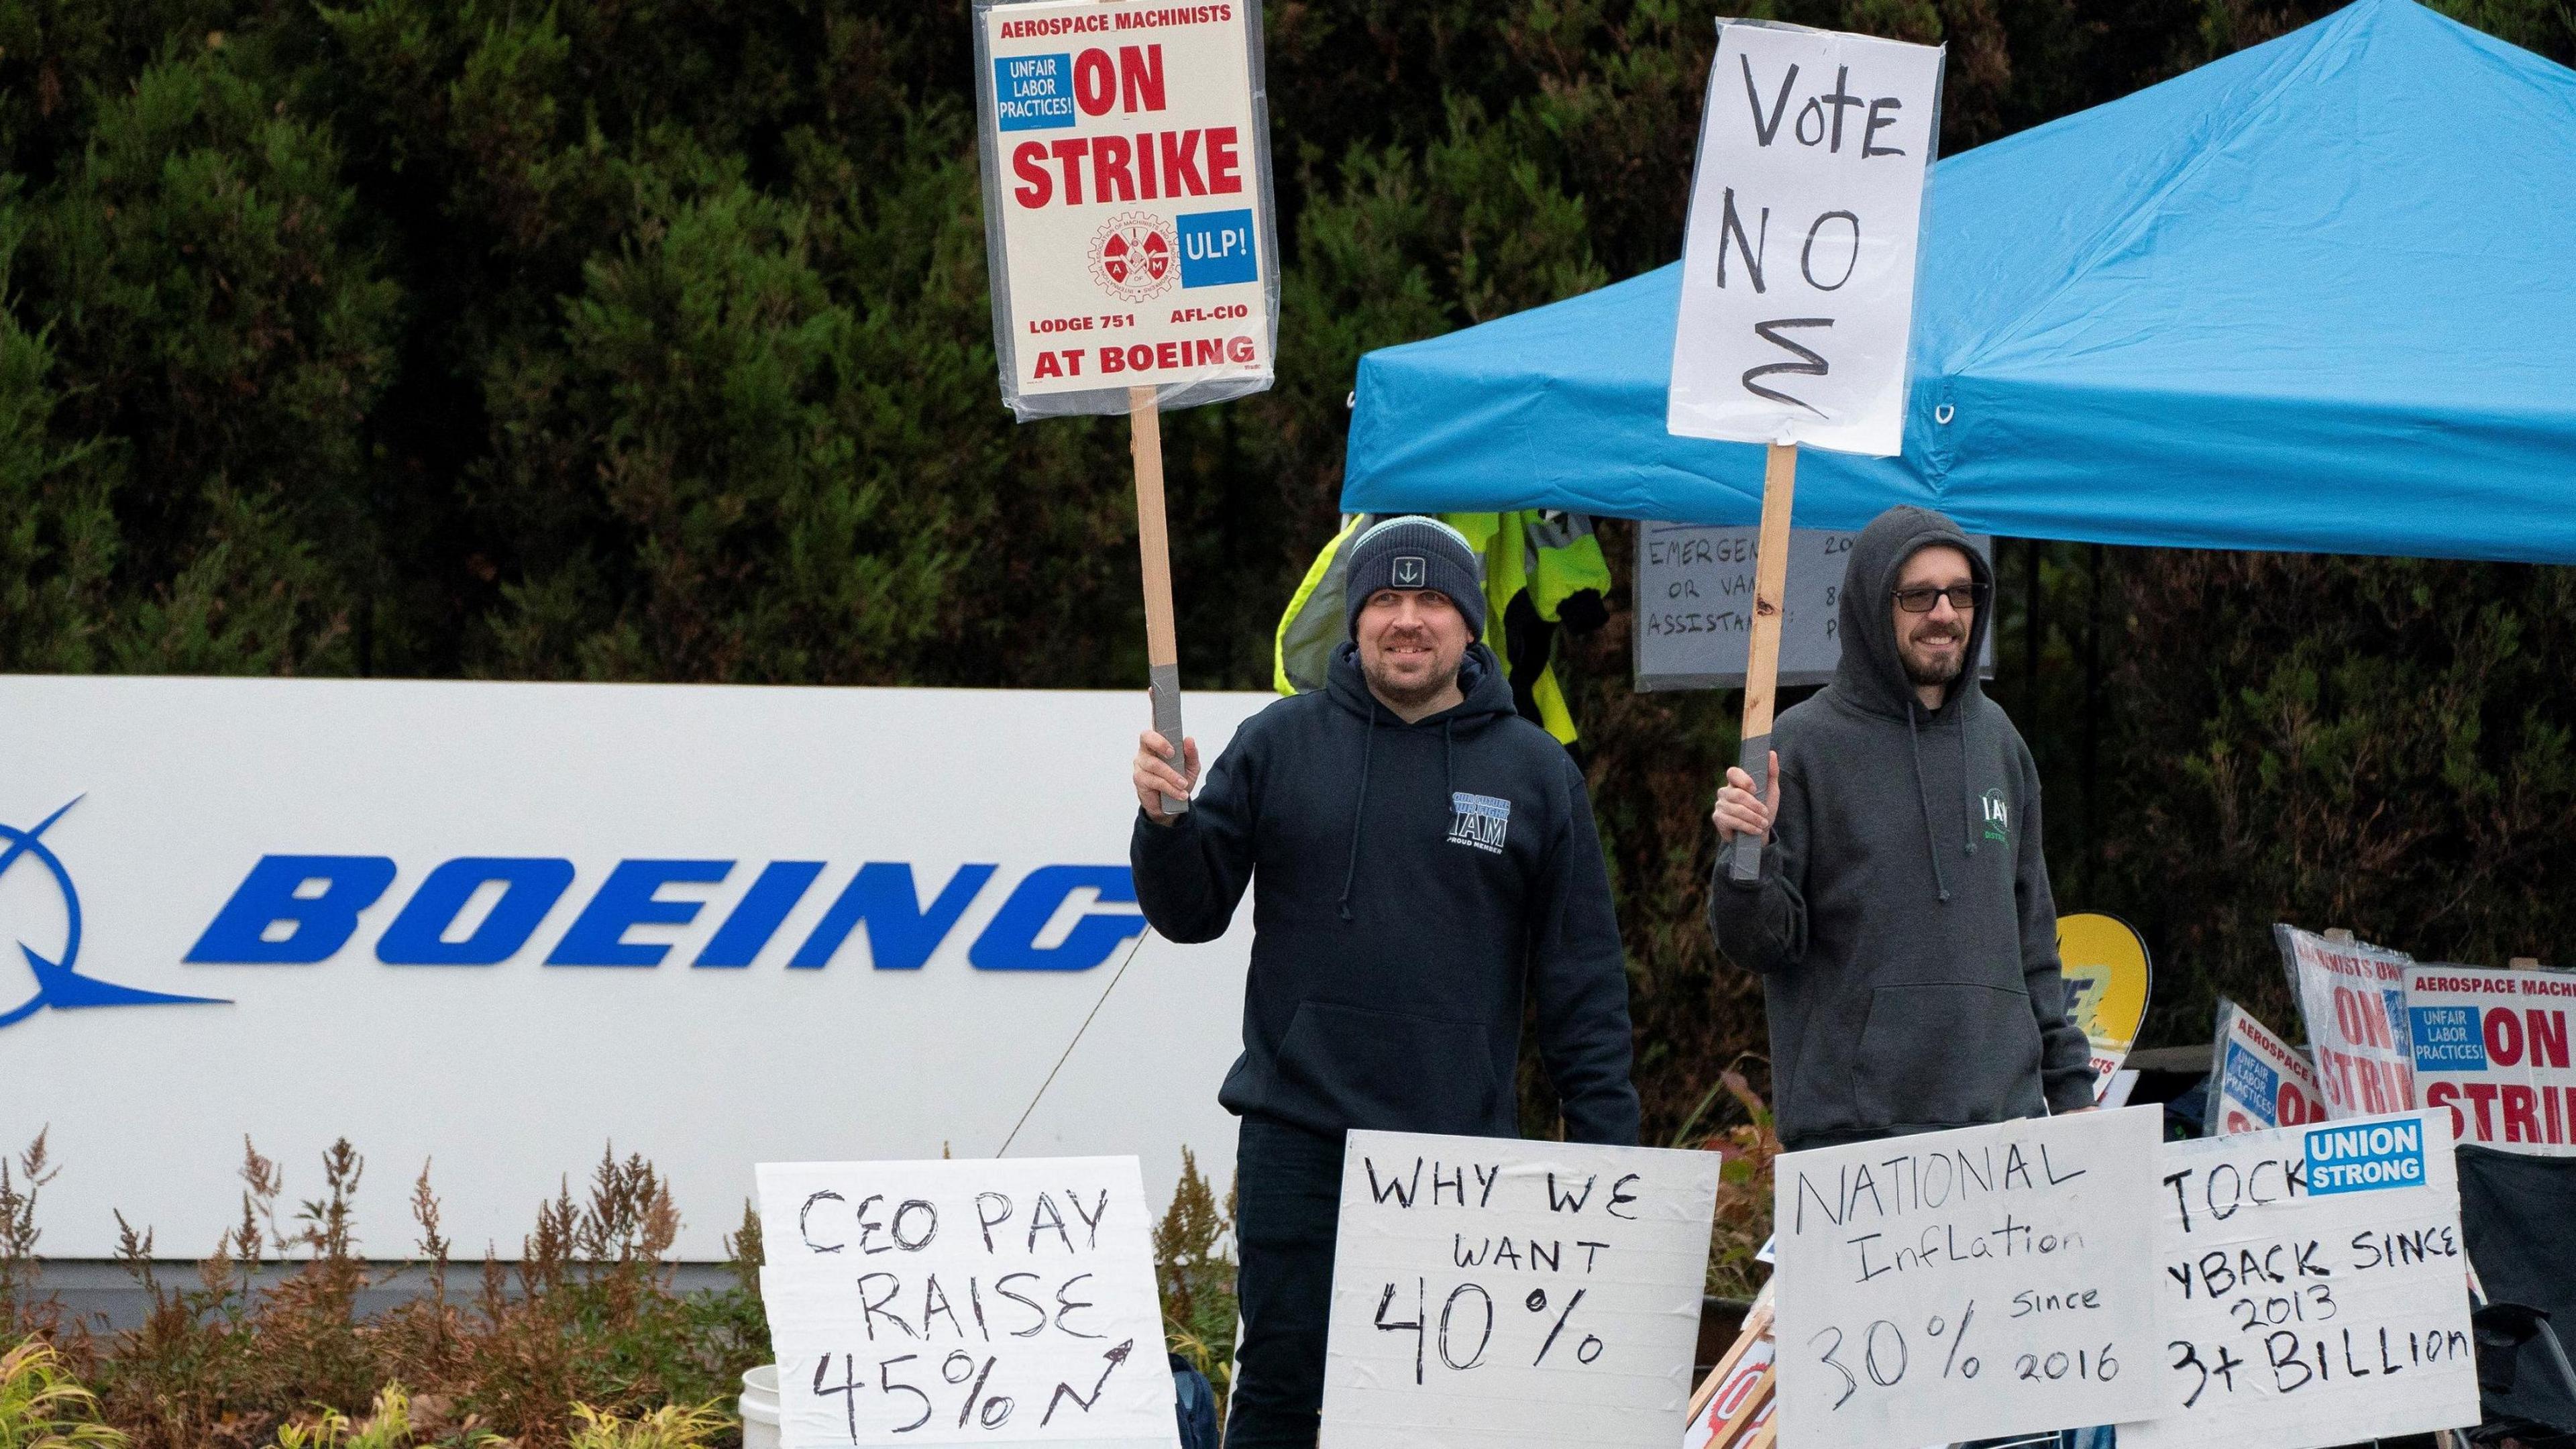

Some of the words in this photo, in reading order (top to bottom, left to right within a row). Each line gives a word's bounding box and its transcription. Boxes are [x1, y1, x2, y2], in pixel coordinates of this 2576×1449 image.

[1001, 15, 1109, 39] AEROSPACE
[1115, 4, 1232, 30] MACHINISTS
[1010, 59, 1057, 78] UNFAIR
[1073, 44, 1167, 117] ON
[1014, 78, 1056, 97] LABOR
[1000, 97, 1072, 118] PRACTICES!
[1012, 126, 1242, 209] STRIKE
[1124, 219, 1159, 230] MACHINISTS
[1186, 228, 1246, 260] ULP!
[1112, 263, 1122, 274] A
[1152, 261, 1163, 270] M
[1030, 317, 1093, 333] LODGE
[1100, 314, 1134, 329] 751
[1170, 304, 1248, 323] AFL-CIO
[1033, 349, 1085, 379] AT
[1099, 335, 1255, 374] BOEING
[1669, 579, 1699, 598] OR
[1449, 812, 1507, 847] IAM
[1474, 842, 1502, 855] MEMBER
[180, 855, 1148, 972] BOEING
[2415, 976, 2516, 994] AEROSPACE
[2333, 985, 2392, 1050] ON
[2423, 1010, 2467, 1025] UNFAIR
[2428, 1027, 2467, 1042] LABOR
[2238, 1018, 2308, 1081] AEROSPACE
[2416, 1044, 2483, 1060] PRACTICES!
[2483, 1006, 2571, 1069] ON
[2238, 1065, 2267, 1095] LABOR
[2310, 1125, 2418, 1161] UNION
[1364, 1157, 1499, 1208] WHY
[1548, 1172, 1640, 1220] WE
[1796, 1144, 2086, 1235] NATIONAL
[2312, 1157, 2420, 1188] STRONG
[800, 1189, 939, 1254] CEO
[975, 1189, 1107, 1254] PAY
[1454, 1232, 1610, 1273] WANT
[2351, 1226, 2458, 1269] SINCE
[858, 1272, 1108, 1342] RAISE
[2231, 1285, 2337, 1332] 2013
[1807, 1299, 1980, 1411] 30%
[2015, 1343, 2119, 1382] 2016
[813, 1349, 1015, 1445] 45%
